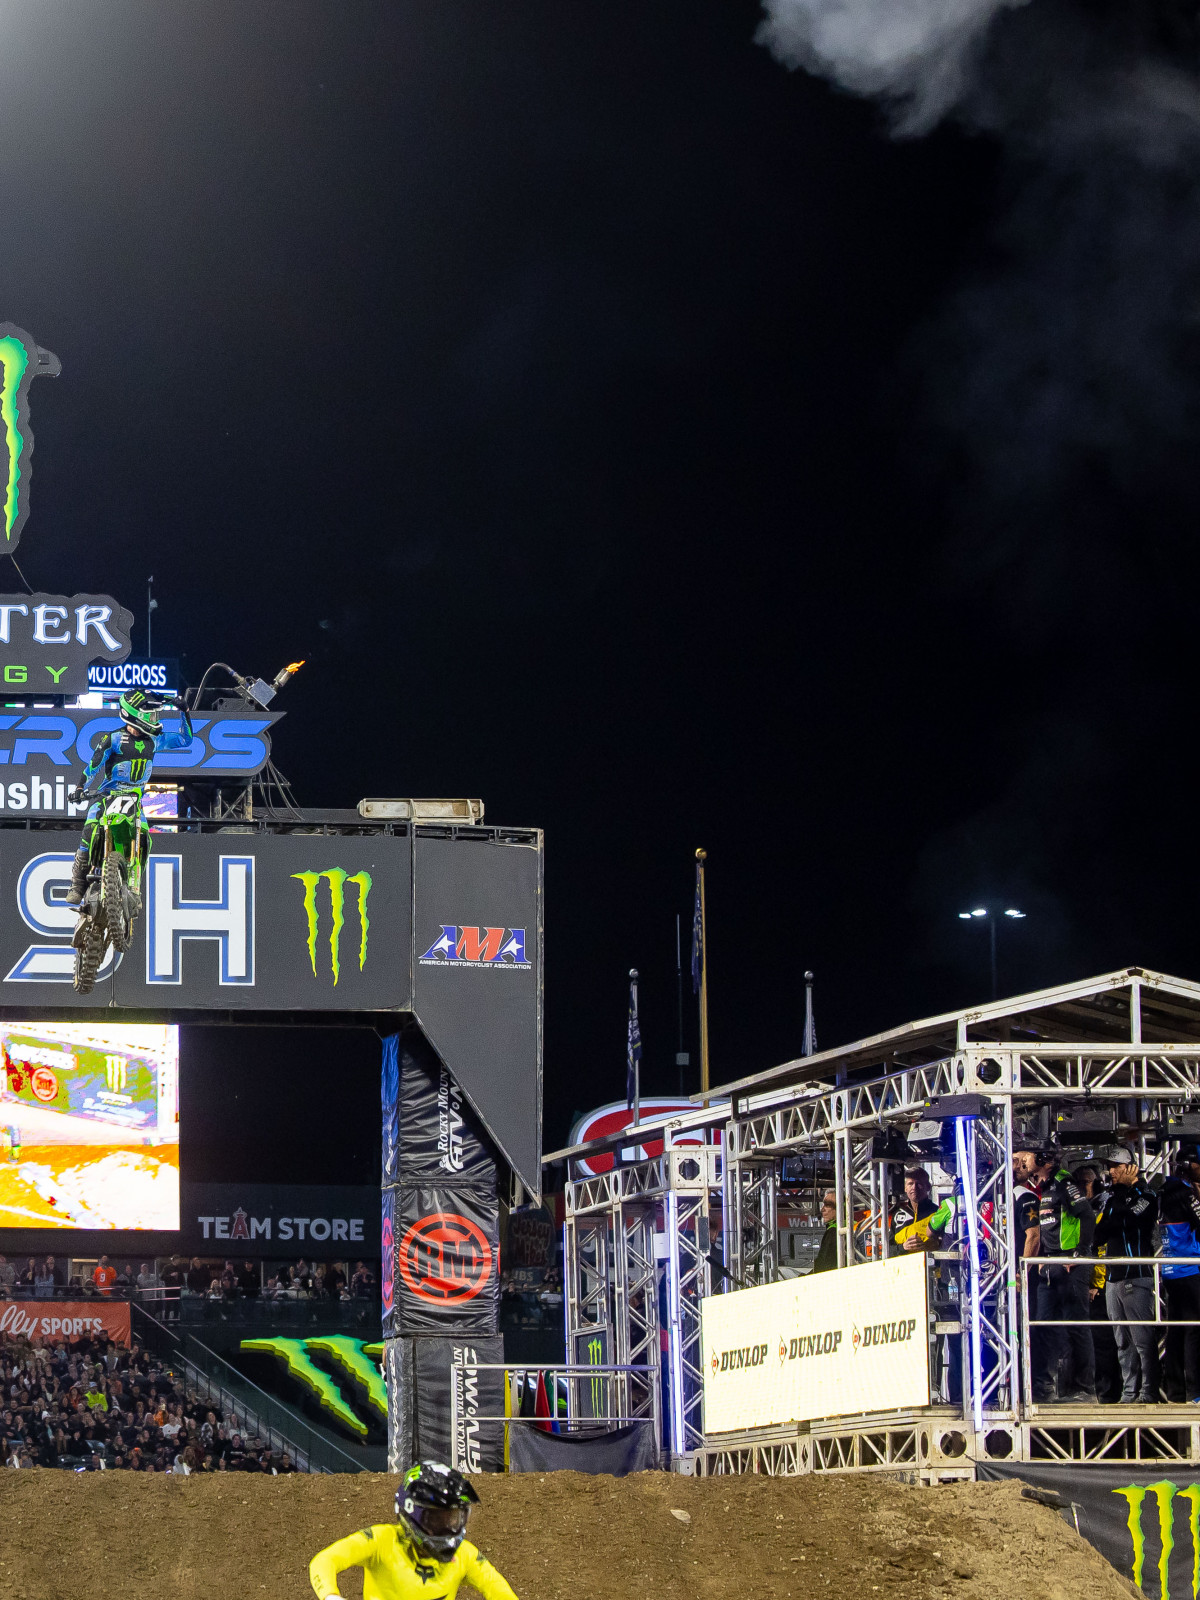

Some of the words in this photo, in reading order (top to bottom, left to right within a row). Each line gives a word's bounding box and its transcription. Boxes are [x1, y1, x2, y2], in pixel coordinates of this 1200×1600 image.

[418, 925, 532, 964] AMA
[437, 1111, 449, 1152] ROCKY
[198, 1207, 272, 1241] TEAM
[278, 1217, 365, 1241] STORE
[41, 1317, 103, 1336] SPORTS
[720, 1344, 768, 1372] DUNLOP
[789, 1331, 842, 1360] DUNLOP
[862, 1319, 916, 1347] DUNLOP
